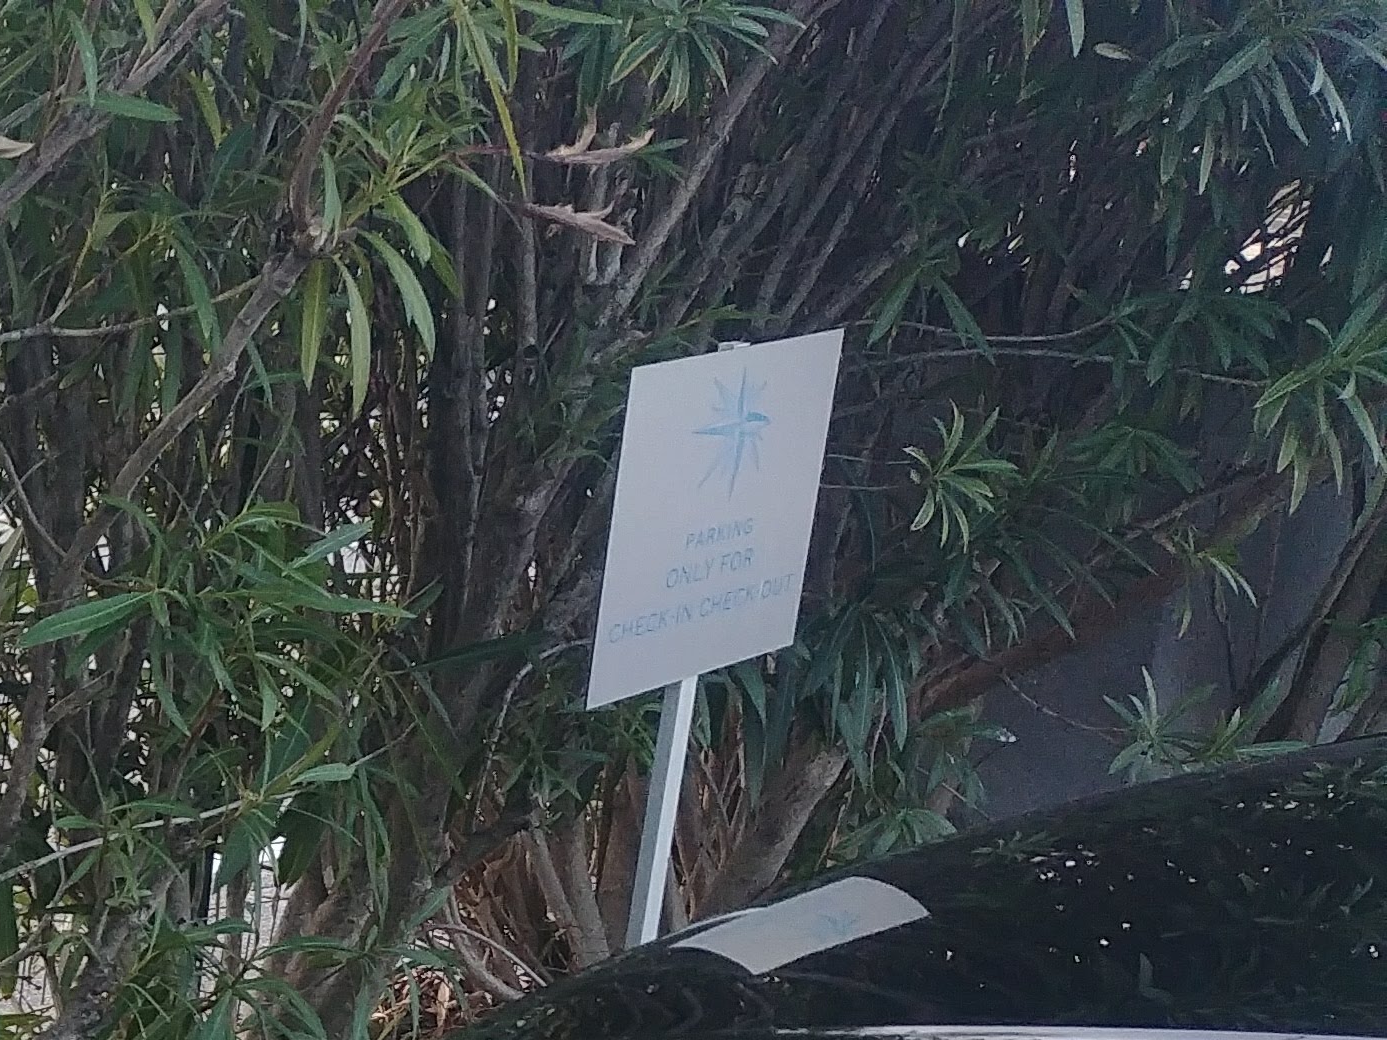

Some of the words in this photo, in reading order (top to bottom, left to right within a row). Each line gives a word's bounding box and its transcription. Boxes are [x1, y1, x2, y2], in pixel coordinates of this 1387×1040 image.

[686, 518, 754, 548] PARKING
[666, 559, 714, 588] ONLY
[720, 548, 754, 573] FOR
[609, 603, 692, 643] CHECK-IN
